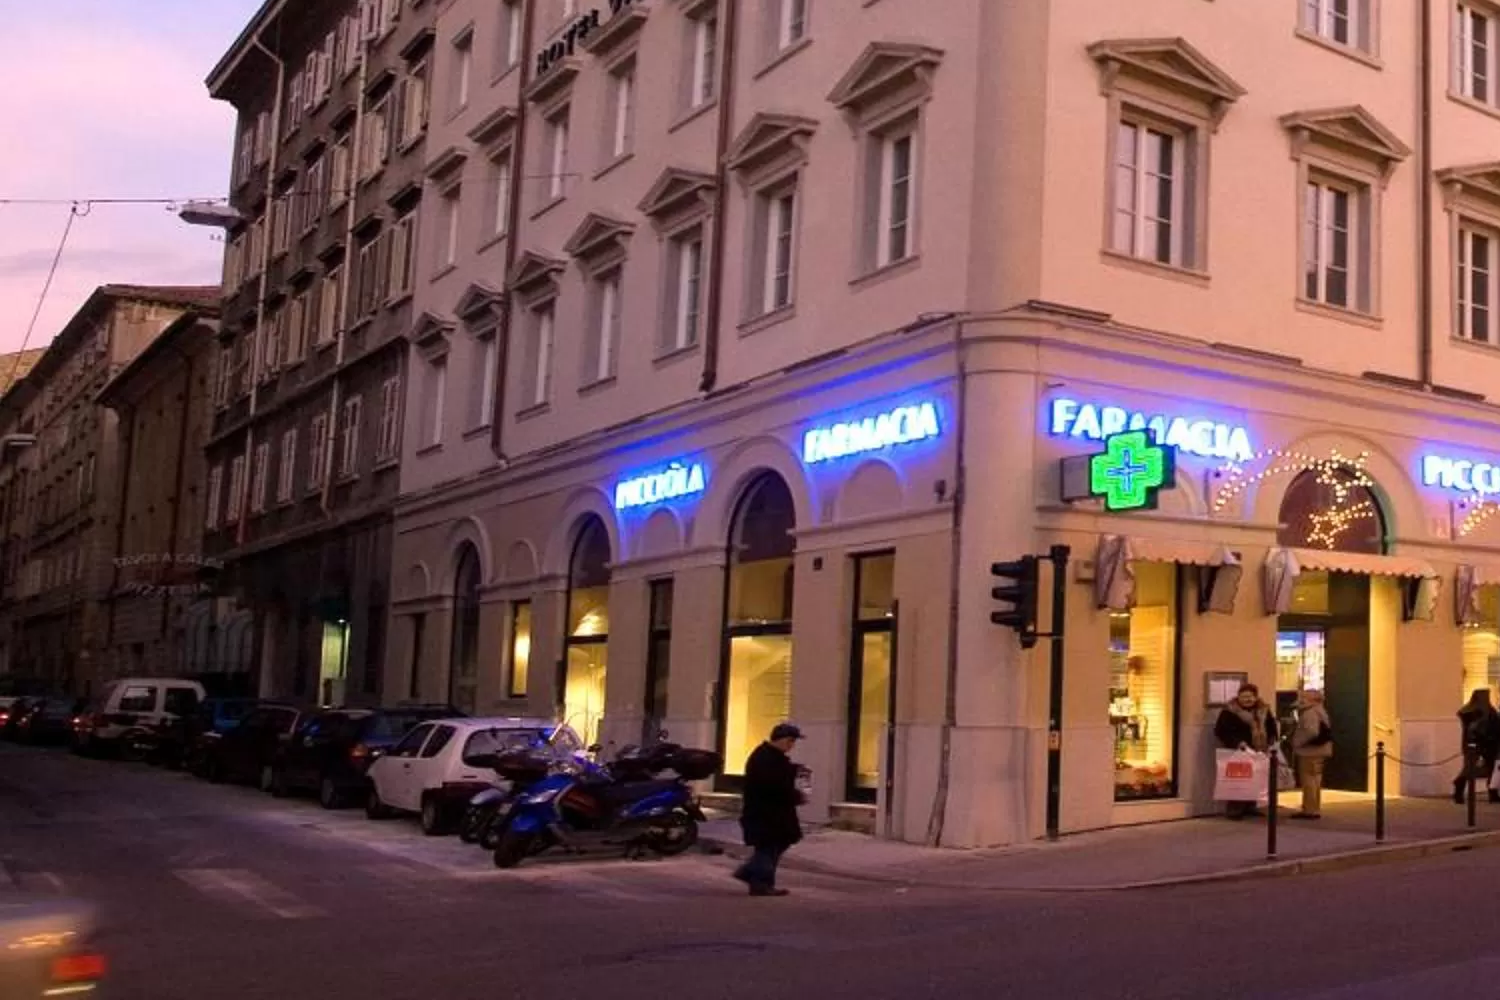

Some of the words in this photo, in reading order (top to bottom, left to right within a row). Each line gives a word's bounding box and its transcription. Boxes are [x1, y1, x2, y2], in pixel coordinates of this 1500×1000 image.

[536, 8, 600, 75] HOTEL
[803, 402, 939, 464] FARMACIA
[1049, 397, 1254, 462] FARMACIA
